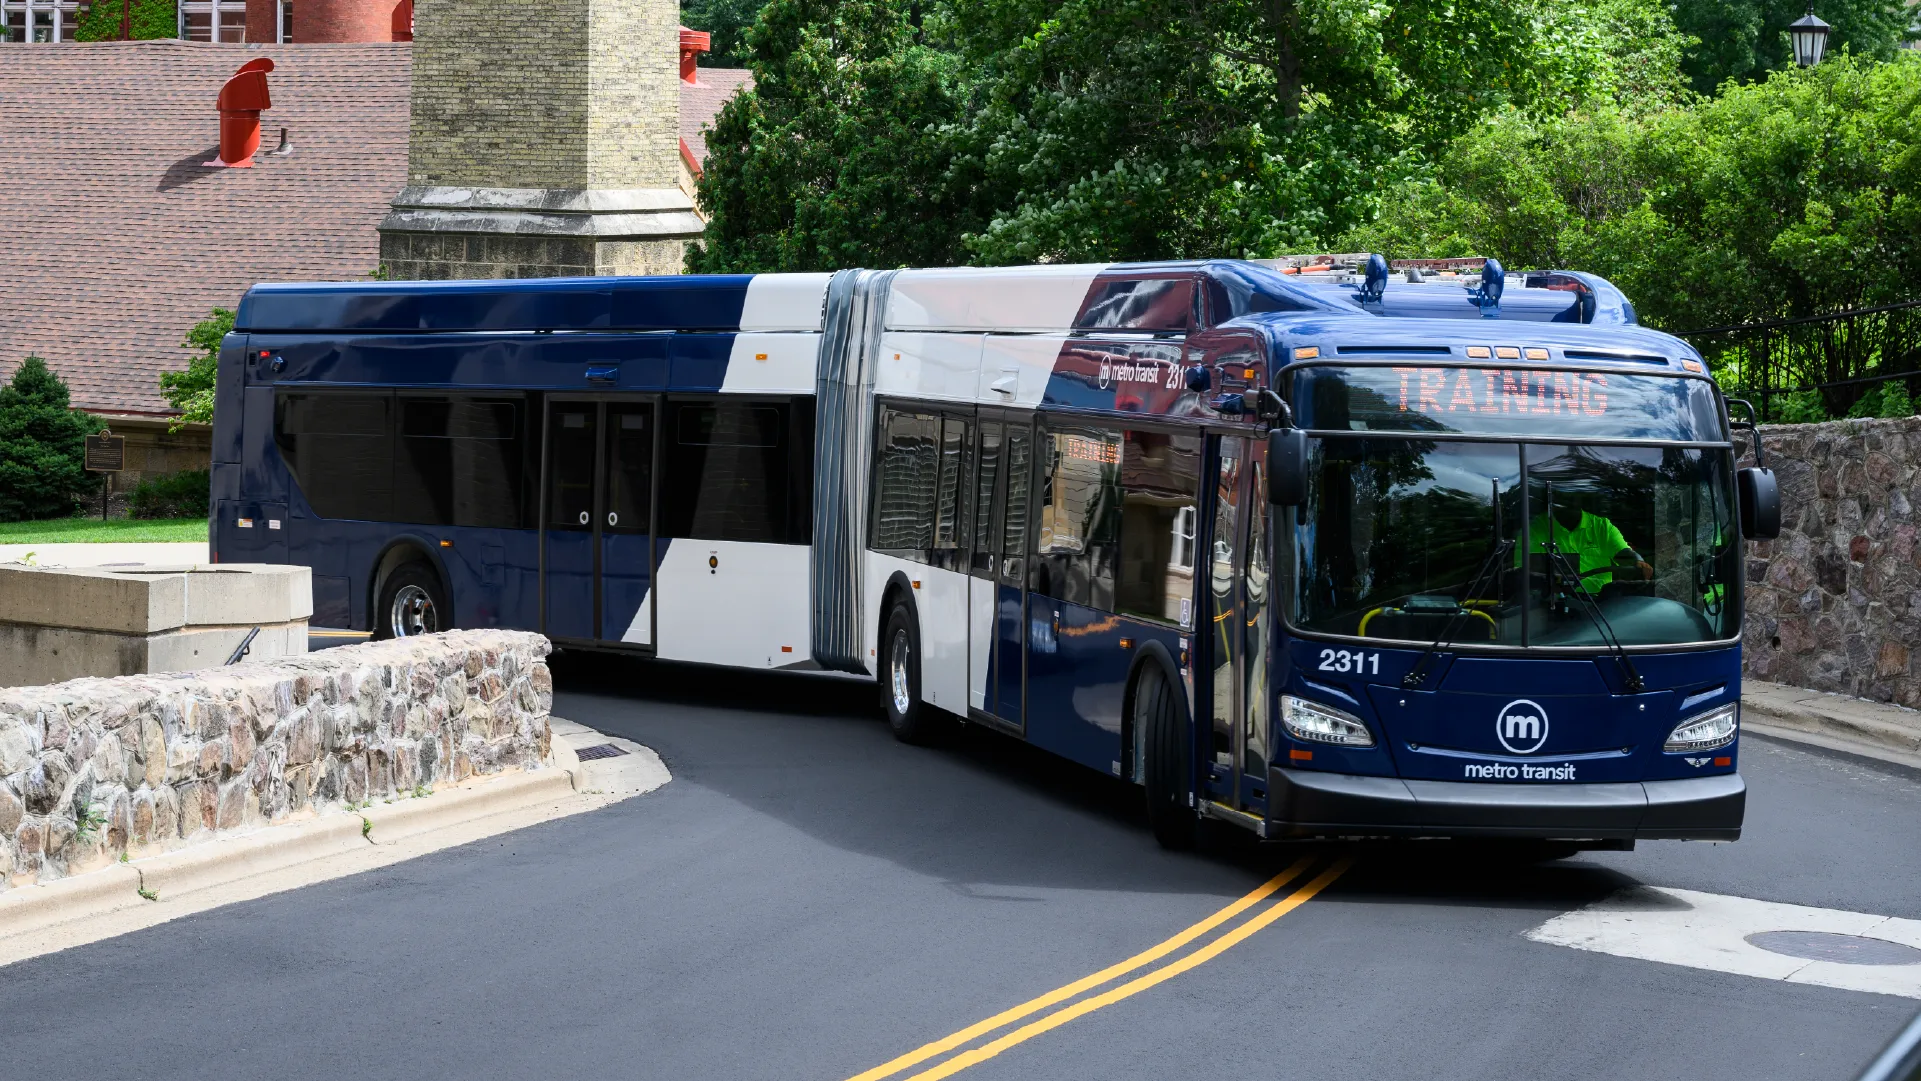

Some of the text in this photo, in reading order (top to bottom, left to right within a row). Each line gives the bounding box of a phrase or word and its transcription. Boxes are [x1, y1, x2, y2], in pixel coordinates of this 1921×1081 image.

[1111, 363, 1134, 382] metro
[1134, 362, 1160, 384] transit
[1392, 367, 1608, 416] TRAINING
[1318, 648, 1380, 675] 2311
[1505, 715, 1540, 739] m
[1464, 762, 1576, 780] metro transit
